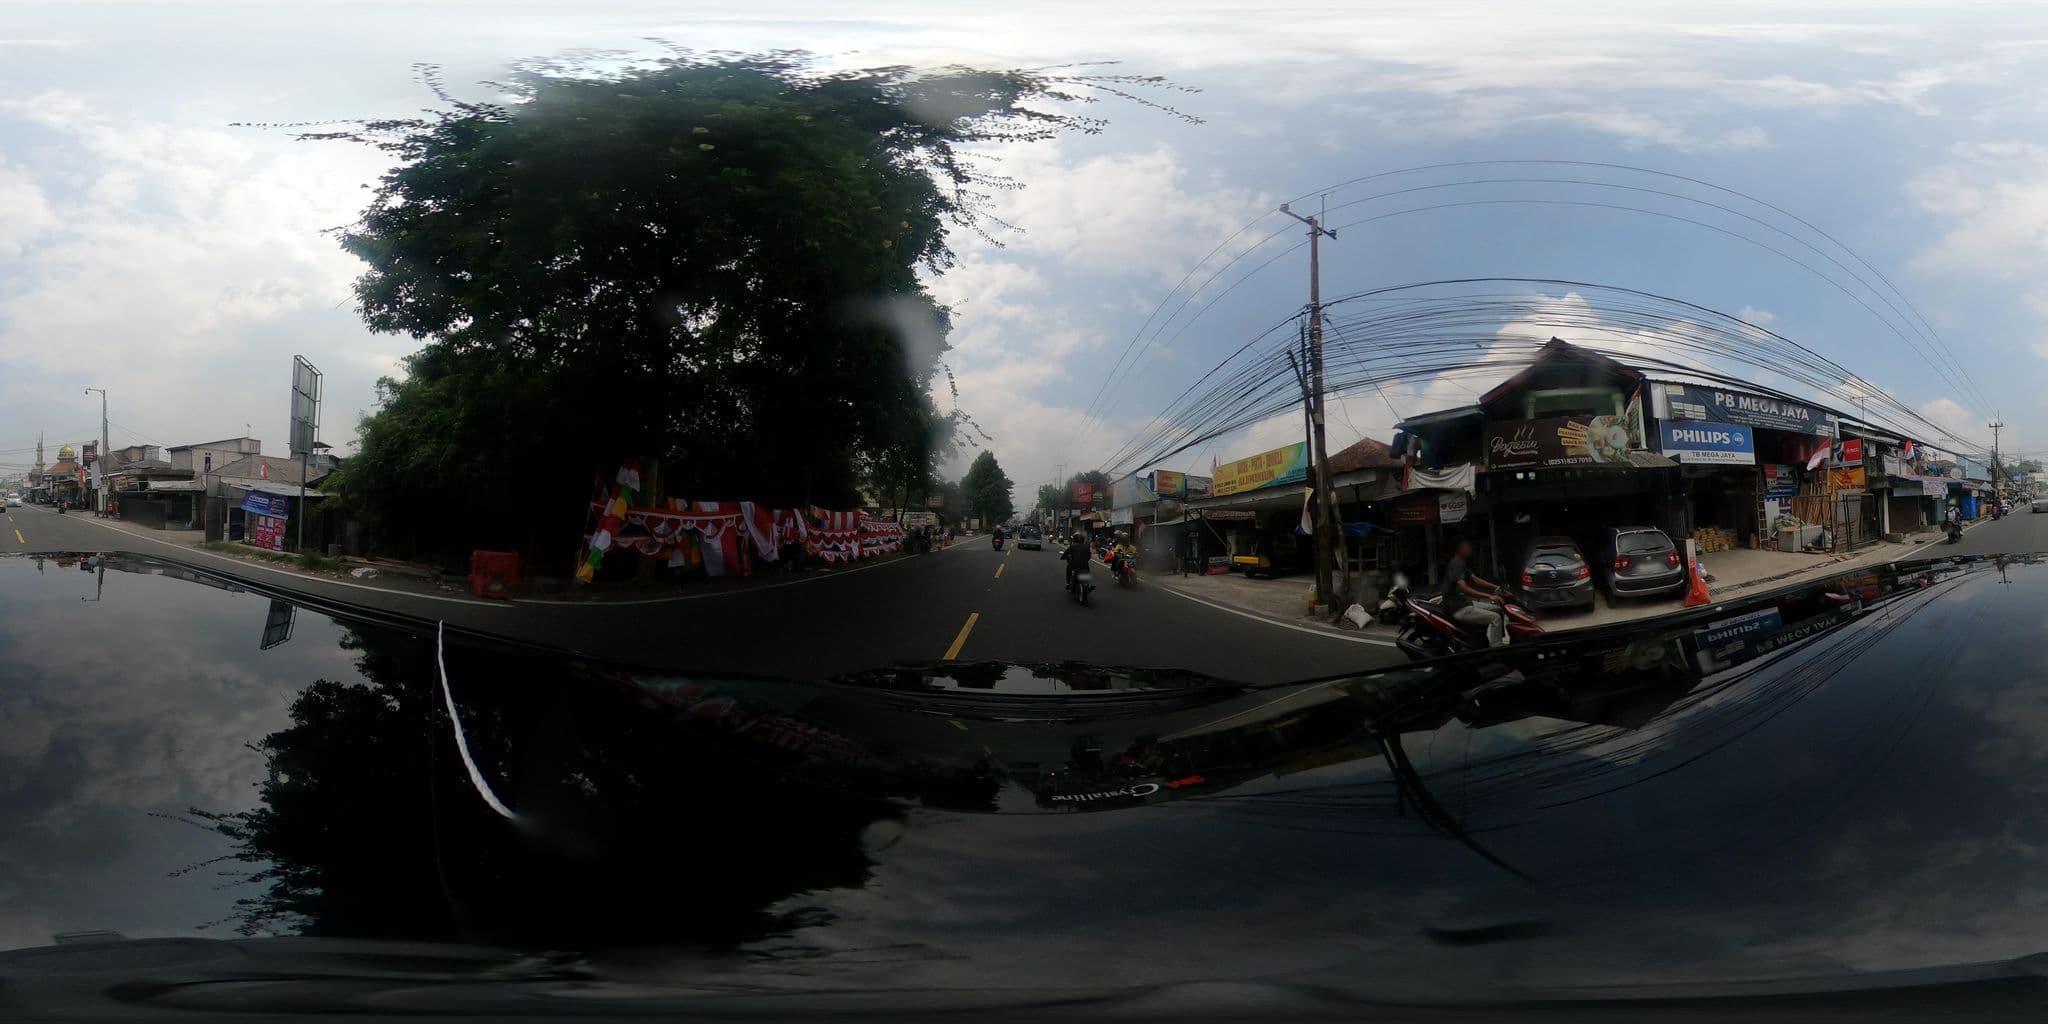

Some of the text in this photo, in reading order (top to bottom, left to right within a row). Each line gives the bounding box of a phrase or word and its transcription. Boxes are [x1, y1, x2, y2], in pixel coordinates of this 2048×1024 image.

[1715, 392, 1735, 407] PB
[1739, 396, 1779, 415] MEGA
[1781, 404, 1810, 421] JAYA
[1672, 429, 1730, 444] PHILIPS
[1051, 783, 1159, 801] Crystalline
